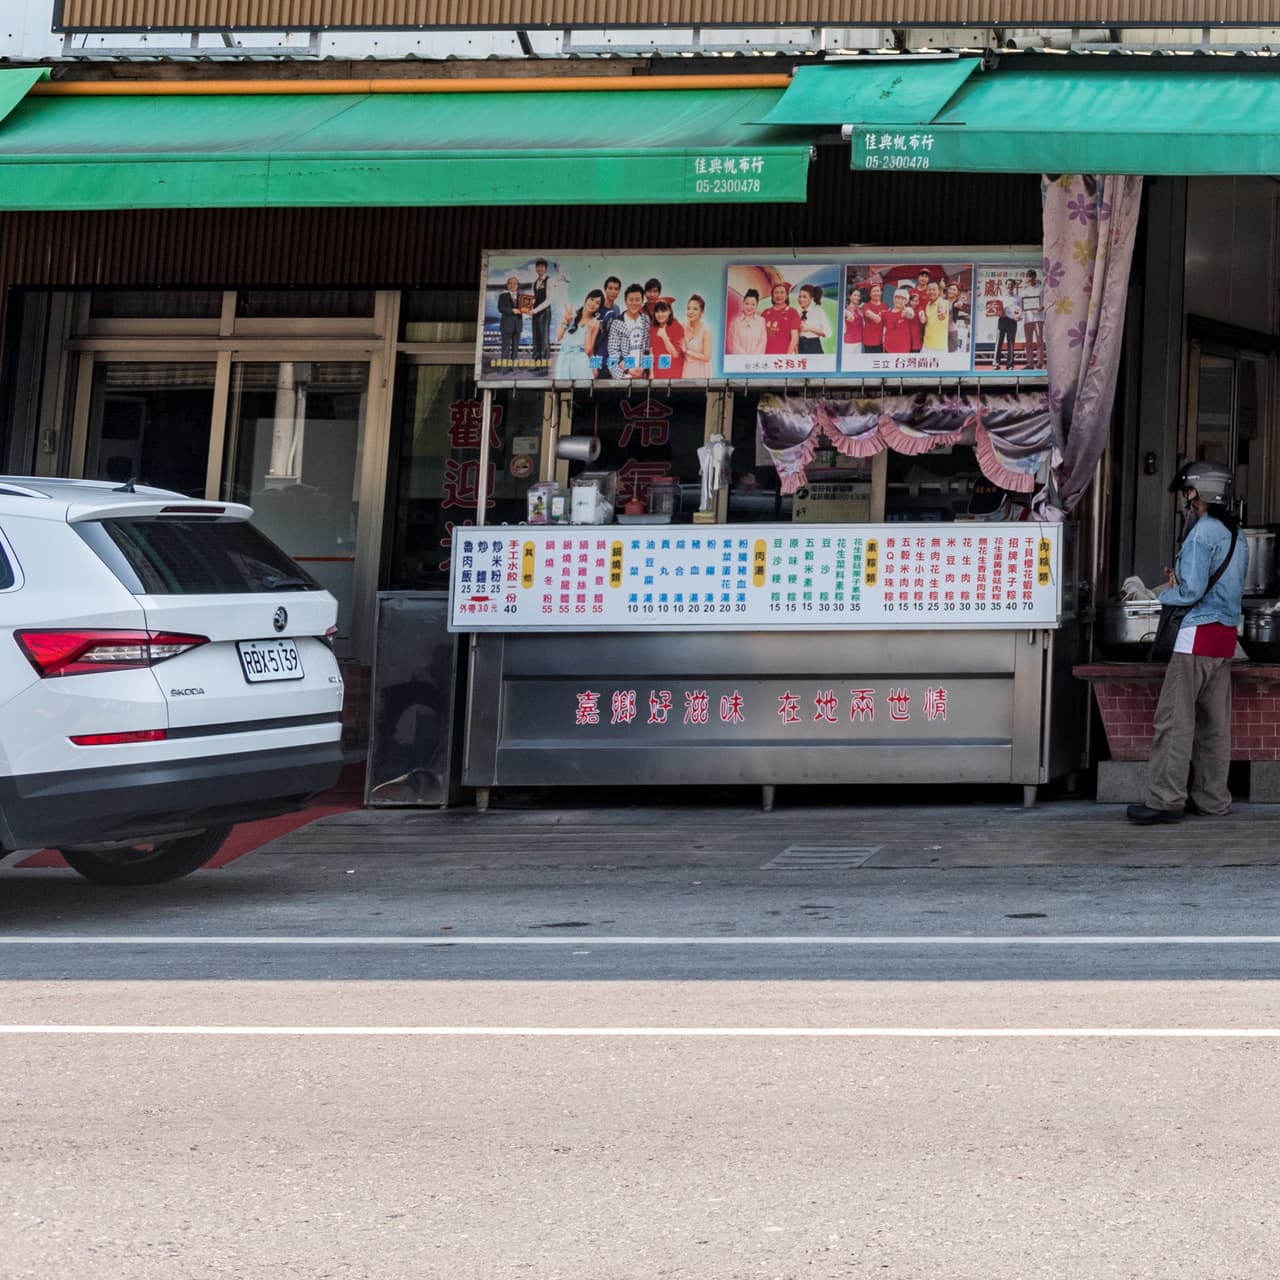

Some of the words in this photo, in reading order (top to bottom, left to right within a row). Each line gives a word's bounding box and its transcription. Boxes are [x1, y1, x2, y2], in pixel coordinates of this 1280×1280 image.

[864, 133, 935, 152] 佳典帆布行
[694, 157, 765, 175] 佳典帆布行
[865, 155, 930, 170] 05-2300478
[696, 178, 761, 193] 05-2300478
[491, 540, 503, 583] 炒米粉
[506, 540, 519, 603] 手工水餃一份
[960, 538, 972, 601] 花生肉粽
[461, 585, 471, 593] 25
[476, 584, 486, 593] 25
[491, 585, 500, 593] 25
[504, 605, 517, 613] 40
[542, 605, 552, 613] 55
[559, 605, 569, 613] 55
[575, 605, 586, 613] 55
[592, 605, 603, 613] 55
[627, 605, 638, 613] 10
[643, 605, 653, 613] 10
[658, 605, 669, 613] 10
[673, 605, 684, 613] 10
[688, 604, 700, 613] 20
[704, 604, 715, 613] 20
[720, 604, 731, 612] 20
[735, 604, 746, 612] 30
[770, 603, 781, 611] 15
[786, 603, 797, 611] 15
[802, 602, 813, 610] 15
[818, 603, 830, 611] 30
[833, 603, 844, 611] 30
[850, 603, 861, 611] 35
[883, 603, 894, 611] 10
[899, 602, 909, 611] 15
[914, 602, 924, 611] 15
[928, 602, 939, 610] 25
[944, 602, 955, 610] 30
[959, 602, 970, 610] 30
[975, 602, 986, 610] 30
[991, 602, 1001, 610] 35
[1006, 602, 1017, 610] 40
[1022, 602, 1034, 610] 70
[243, 648, 298, 675] RBX-5139
[170, 687, 205, 697] SKODA
